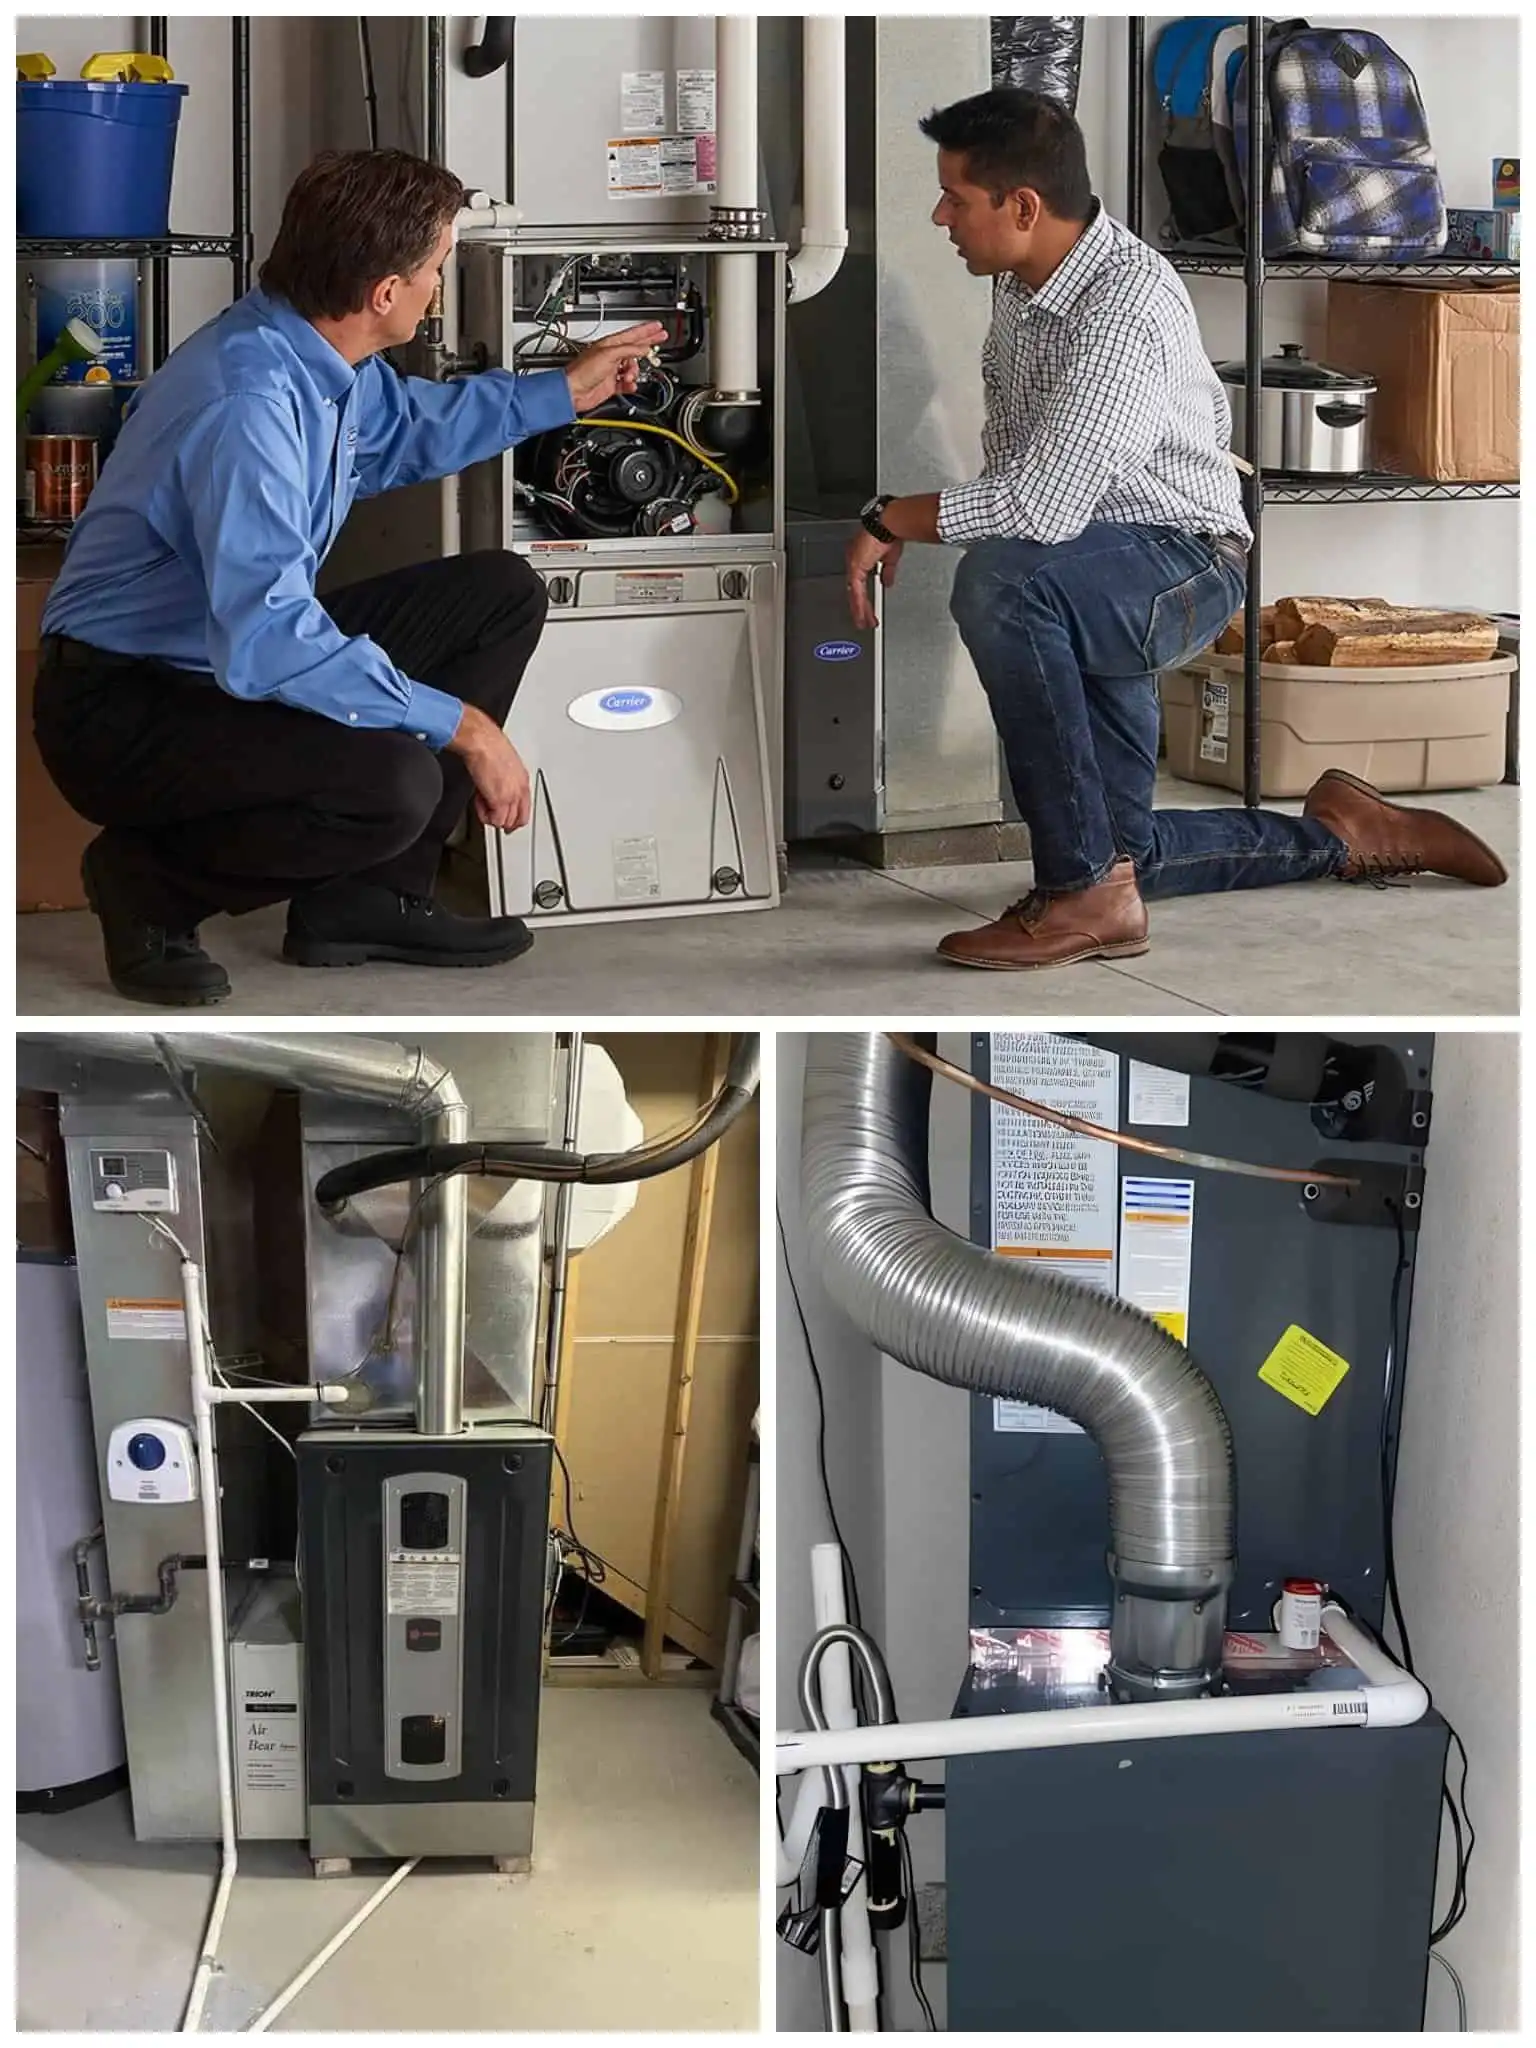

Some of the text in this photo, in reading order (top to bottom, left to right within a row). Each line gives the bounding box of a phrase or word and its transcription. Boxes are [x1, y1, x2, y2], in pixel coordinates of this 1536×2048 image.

[66, 302, 126, 329] 200
[819, 644, 856, 656] Carrier
[606, 695, 645, 709] Carrier
[247, 1722, 269, 1735] Air
